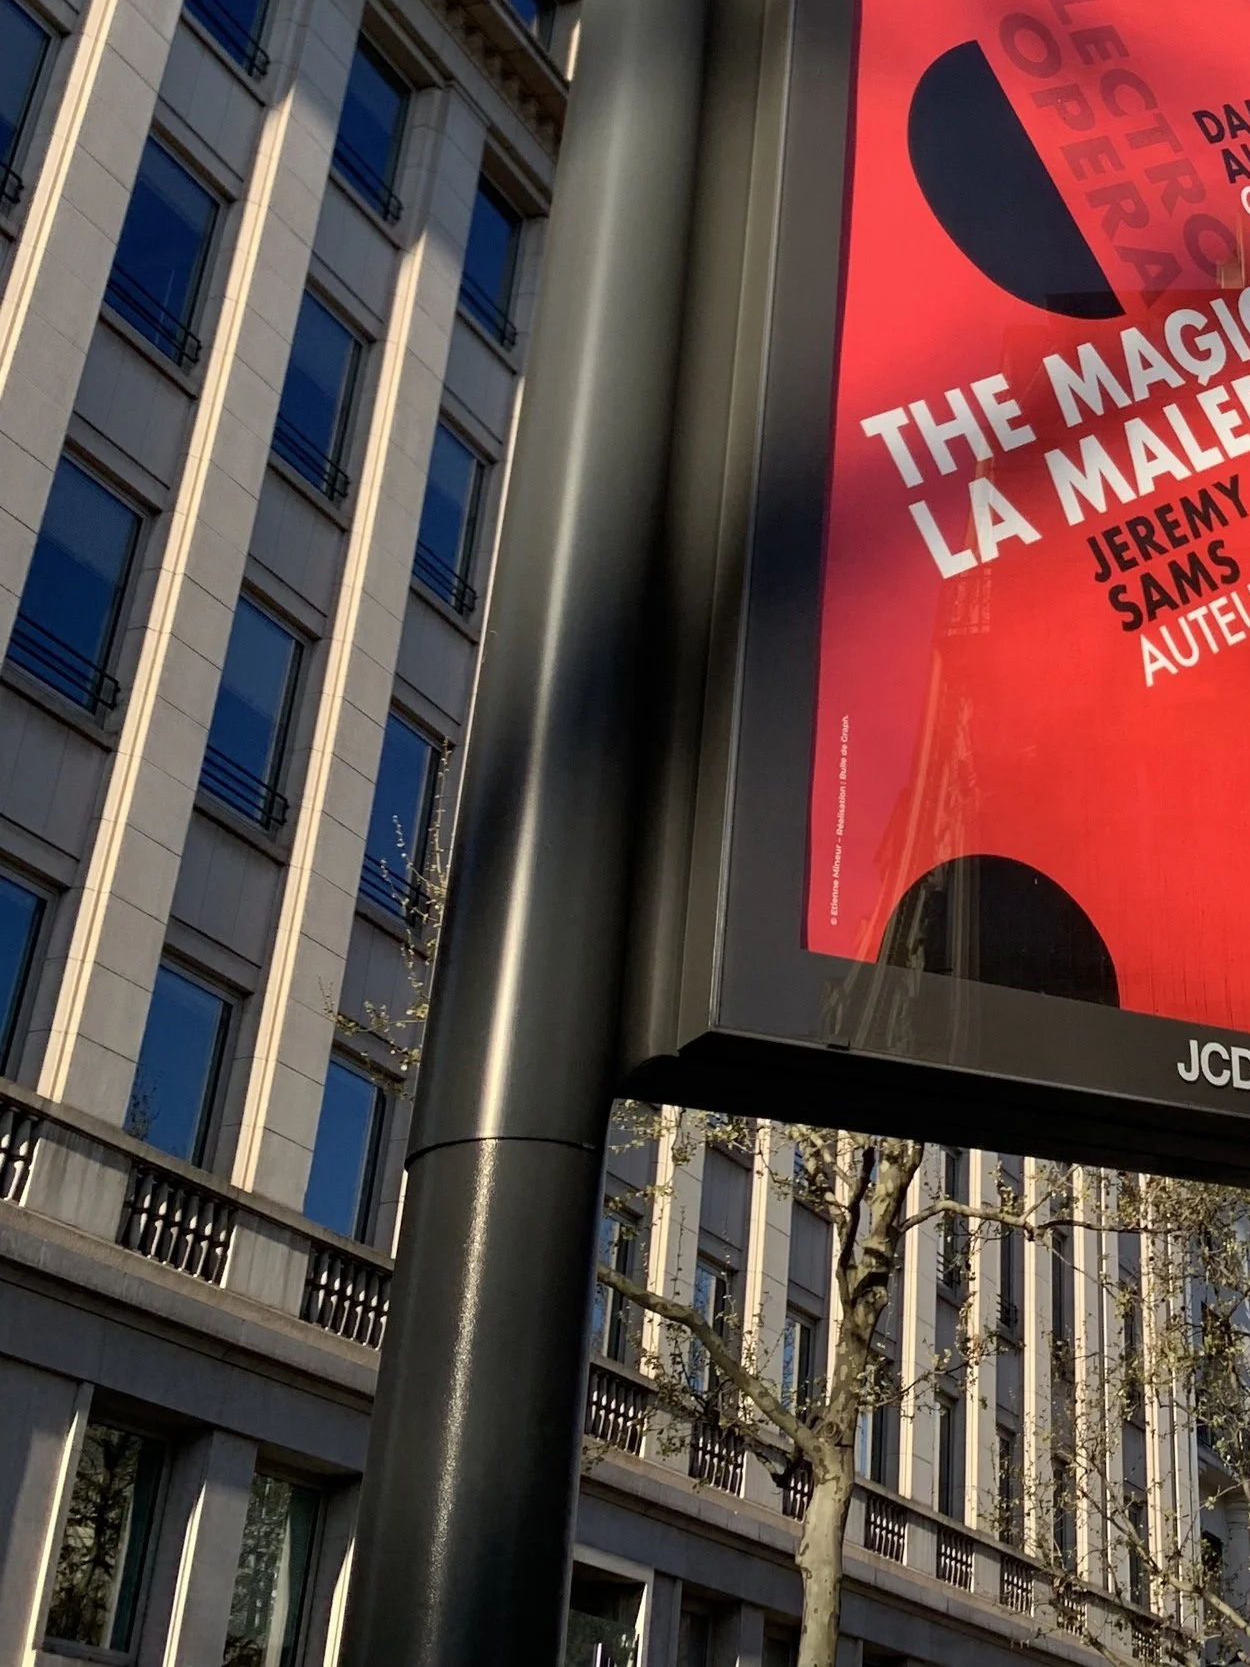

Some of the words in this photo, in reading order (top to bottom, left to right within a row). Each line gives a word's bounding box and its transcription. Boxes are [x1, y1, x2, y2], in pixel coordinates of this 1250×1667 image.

[999, 12, 1183, 309] OPERA
[860, 373, 1036, 488] THE
[908, 475, 1043, 580] LA
[1087, 474, 1250, 582] JEREMY
[1107, 540, 1241, 632] SAMS
[832, 844, 842, 878] Mineur
[840, 744, 848, 756] de
